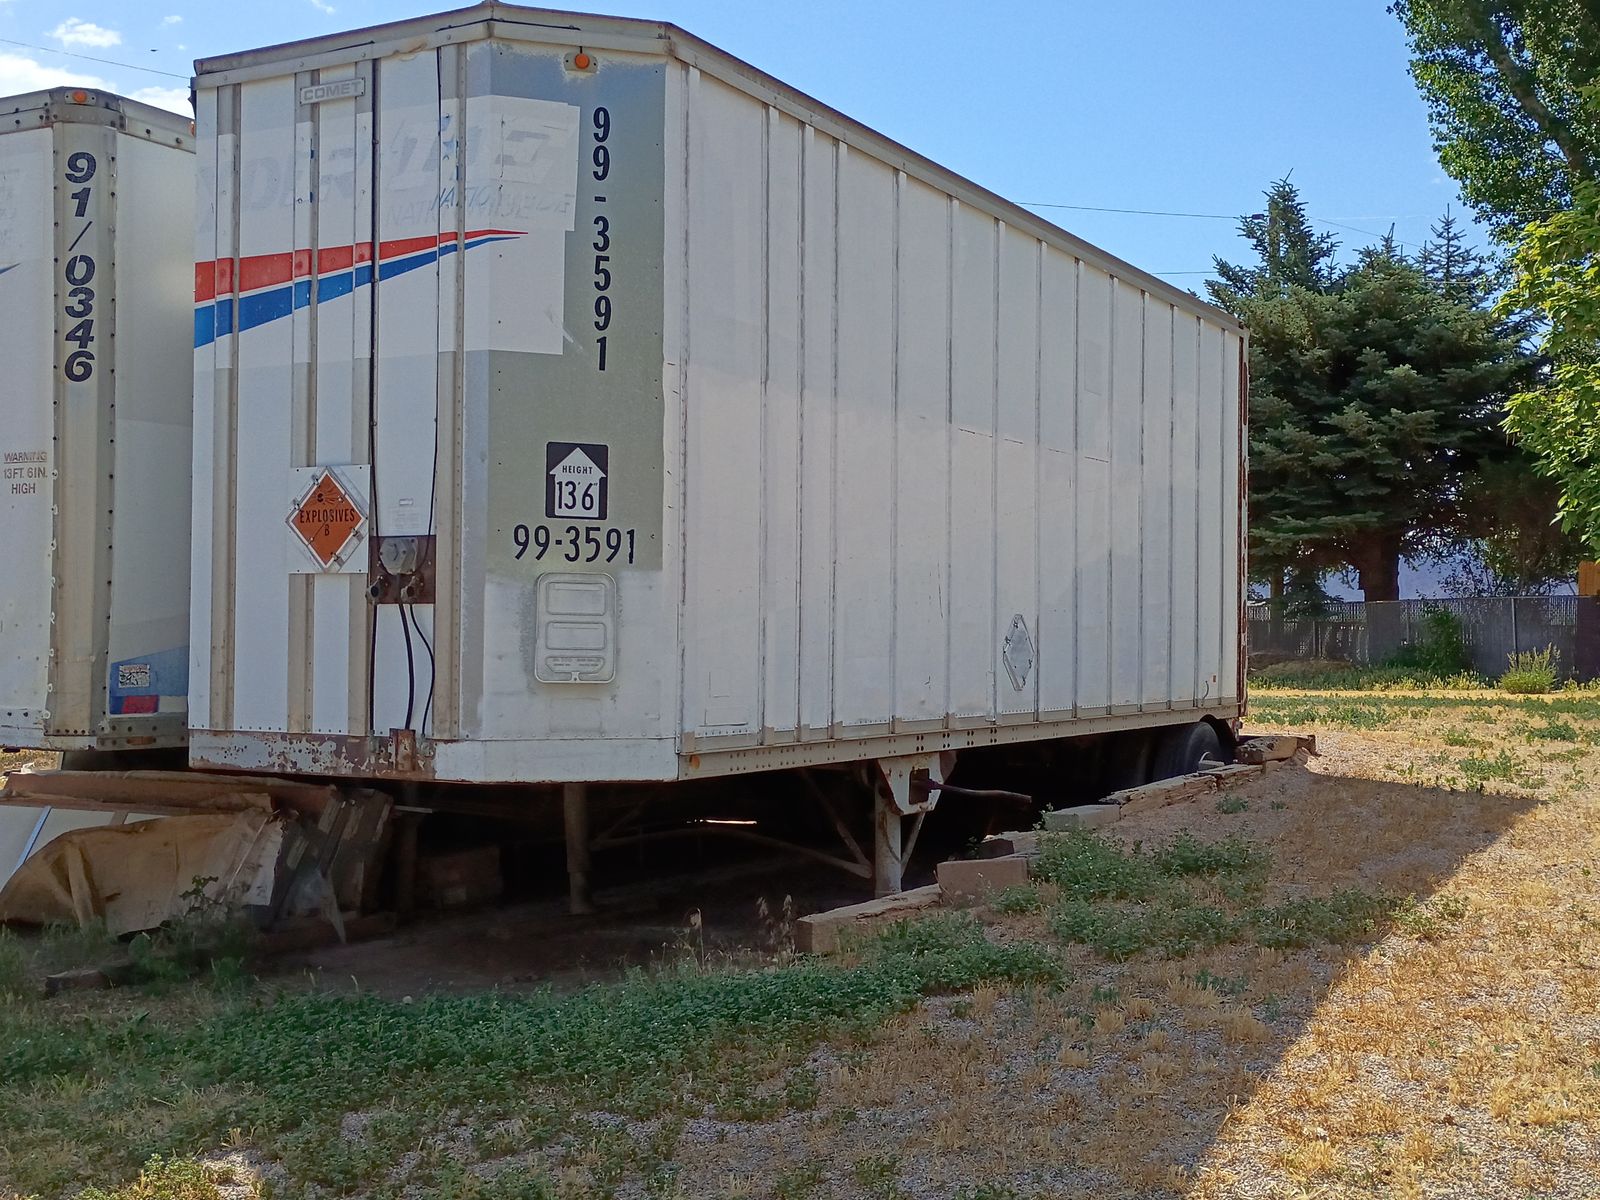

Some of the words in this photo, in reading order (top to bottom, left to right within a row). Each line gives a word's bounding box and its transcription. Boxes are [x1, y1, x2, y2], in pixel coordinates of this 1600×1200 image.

[303, 80, 361, 101] COMET
[592, 106, 612, 372] 99-3591
[64, 151, 97, 383] 91/0346
[562, 465, 593, 475] HEIGHT
[11, 482, 36, 494] HIGH
[299, 508, 355, 523] EXPLOSIVES
[513, 524, 635, 564] 99-3591
